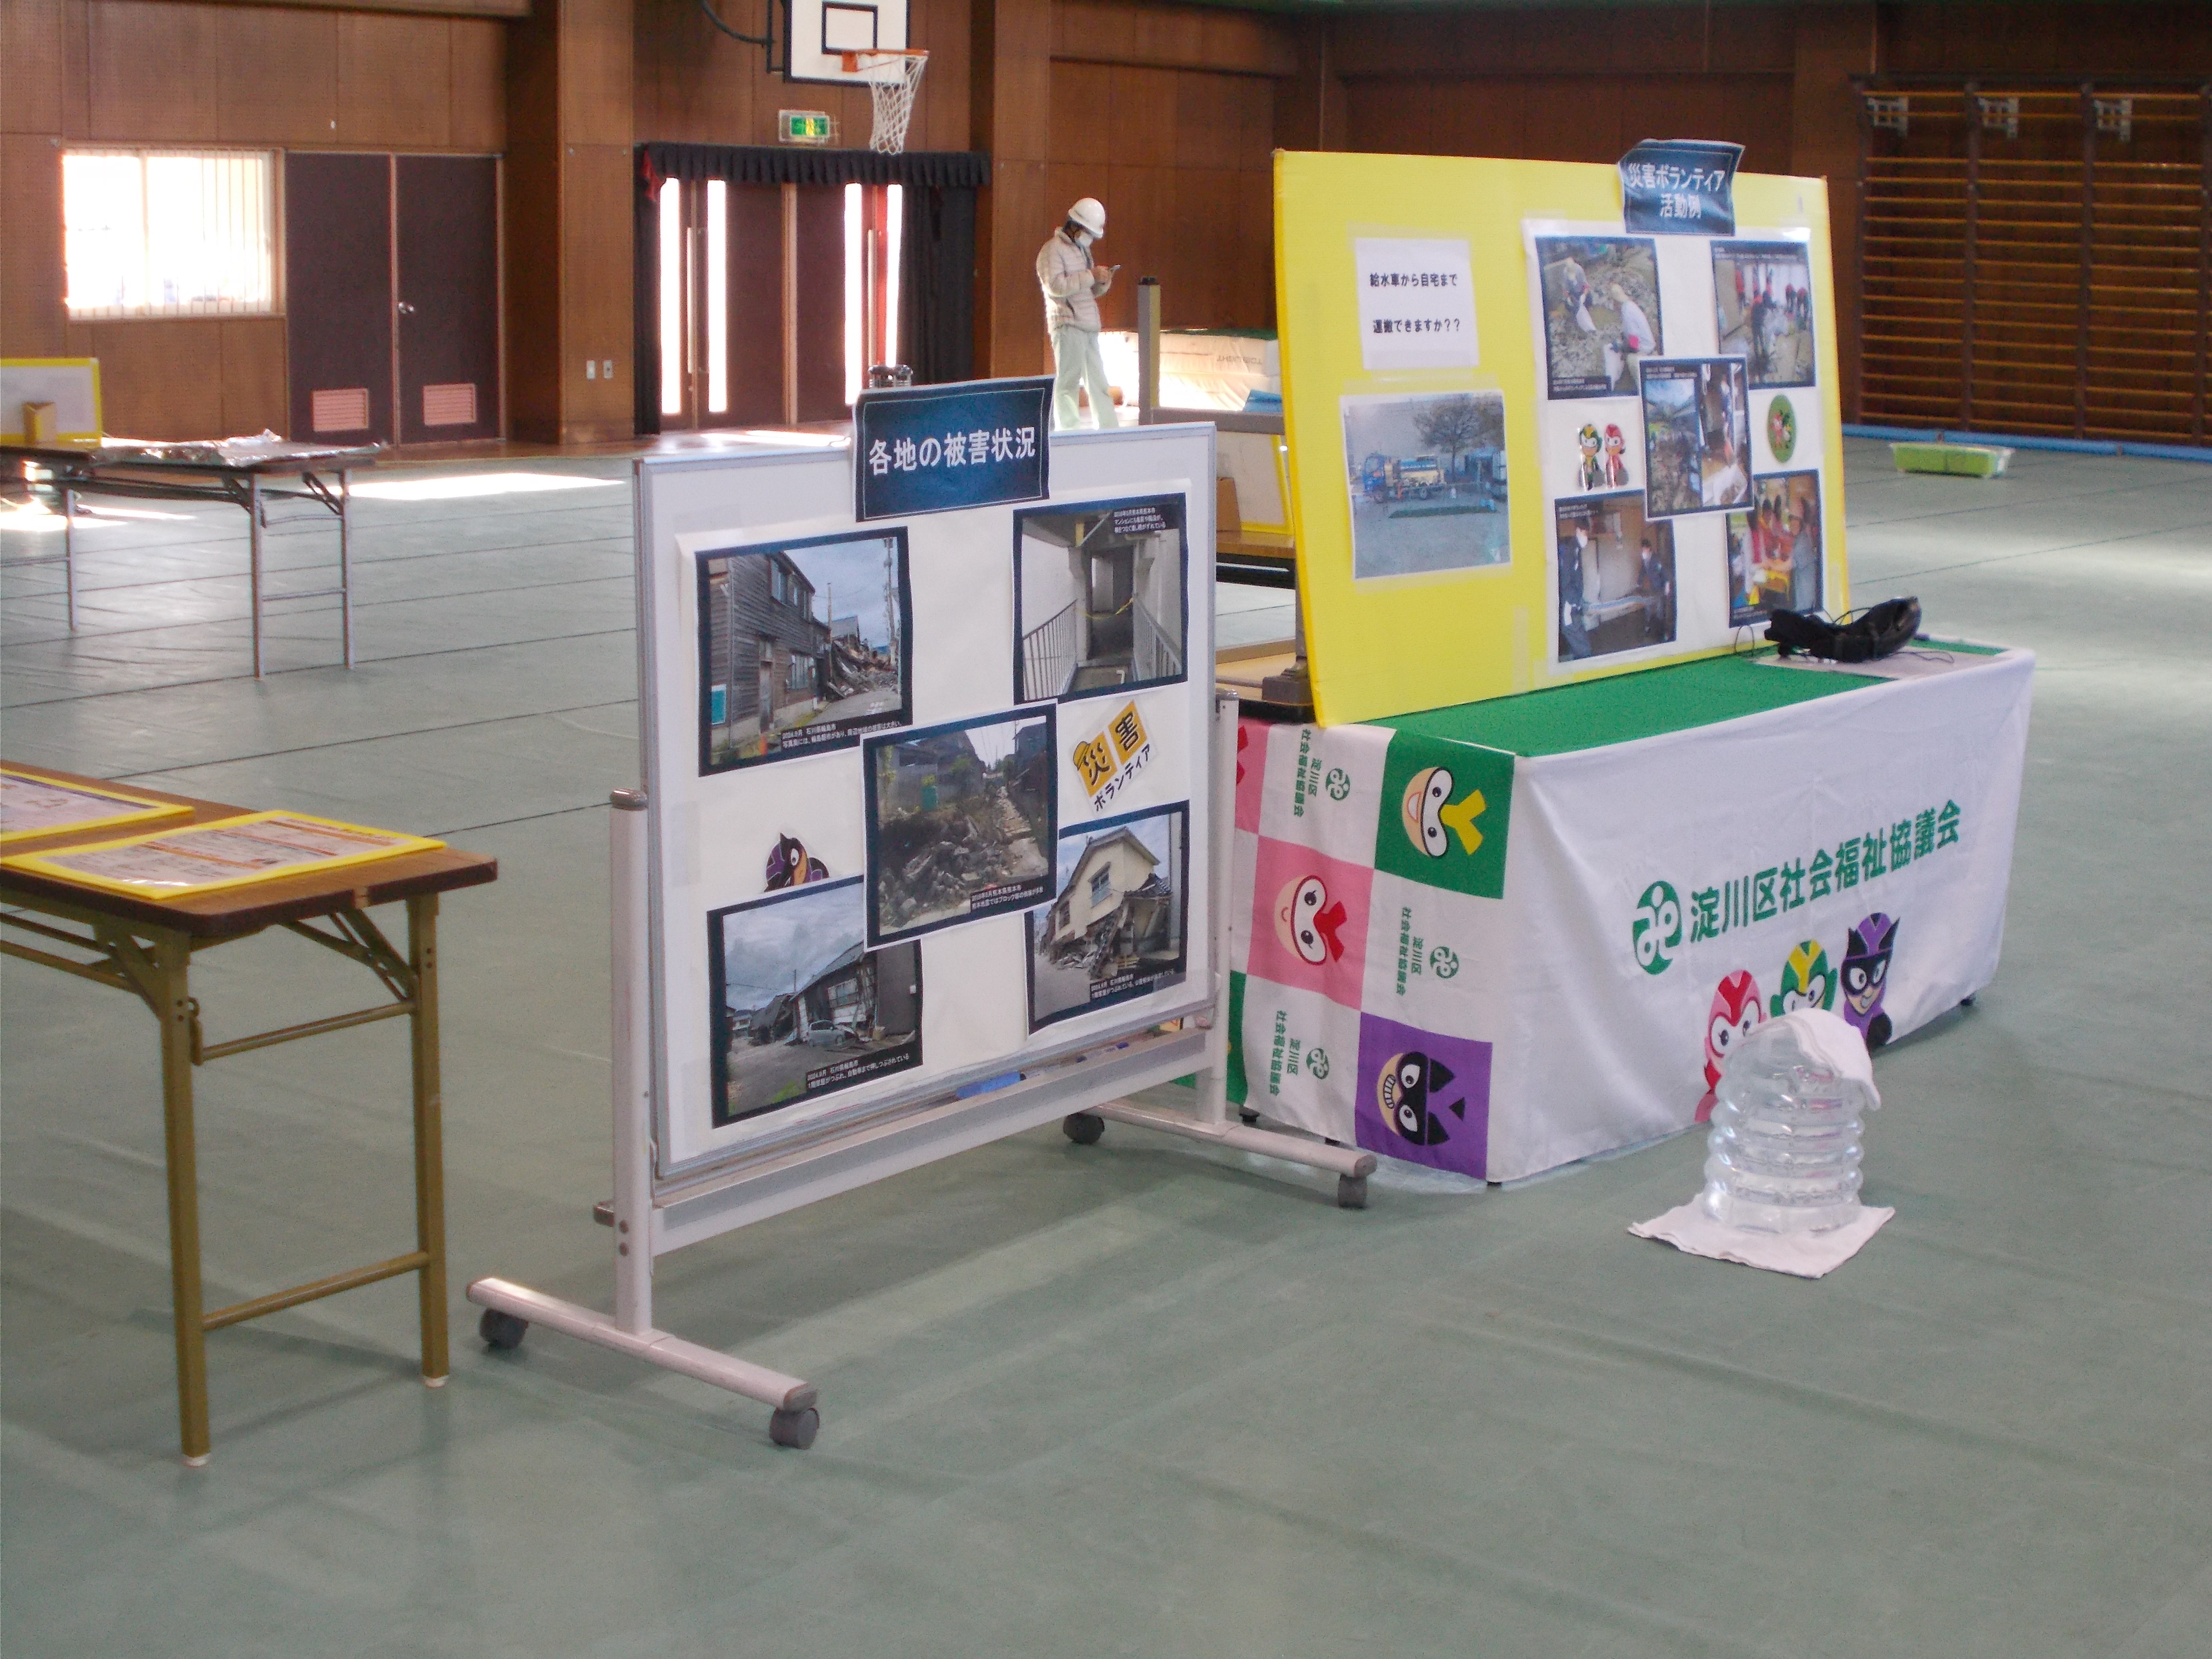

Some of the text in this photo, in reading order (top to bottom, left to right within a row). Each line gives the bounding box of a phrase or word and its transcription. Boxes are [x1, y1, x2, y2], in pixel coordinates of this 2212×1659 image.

[1628, 162, 1726, 192] 災害ボランティア
[1660, 193, 1702, 219] 活動例
[1370, 272, 1458, 287] 給水車から自宅まで
[869, 426, 1036, 477] 各地の被害状況
[1083, 710, 1139, 786] 災害
[1294, 728, 1311, 817] 社会福祉協議会
[1094, 743, 1150, 812] ボランティア
[1308, 757, 1322, 797] 淀川区
[1690, 799, 1961, 943] 淀川区社会福祉協議会
[1396, 906, 1412, 996] 社会福祉協議会
[1411, 936, 1424, 975] 淀川区
[1270, 1010, 1287, 1096] 社会福祉協議会
[1287, 1037, 1301, 1076] 淀川区
